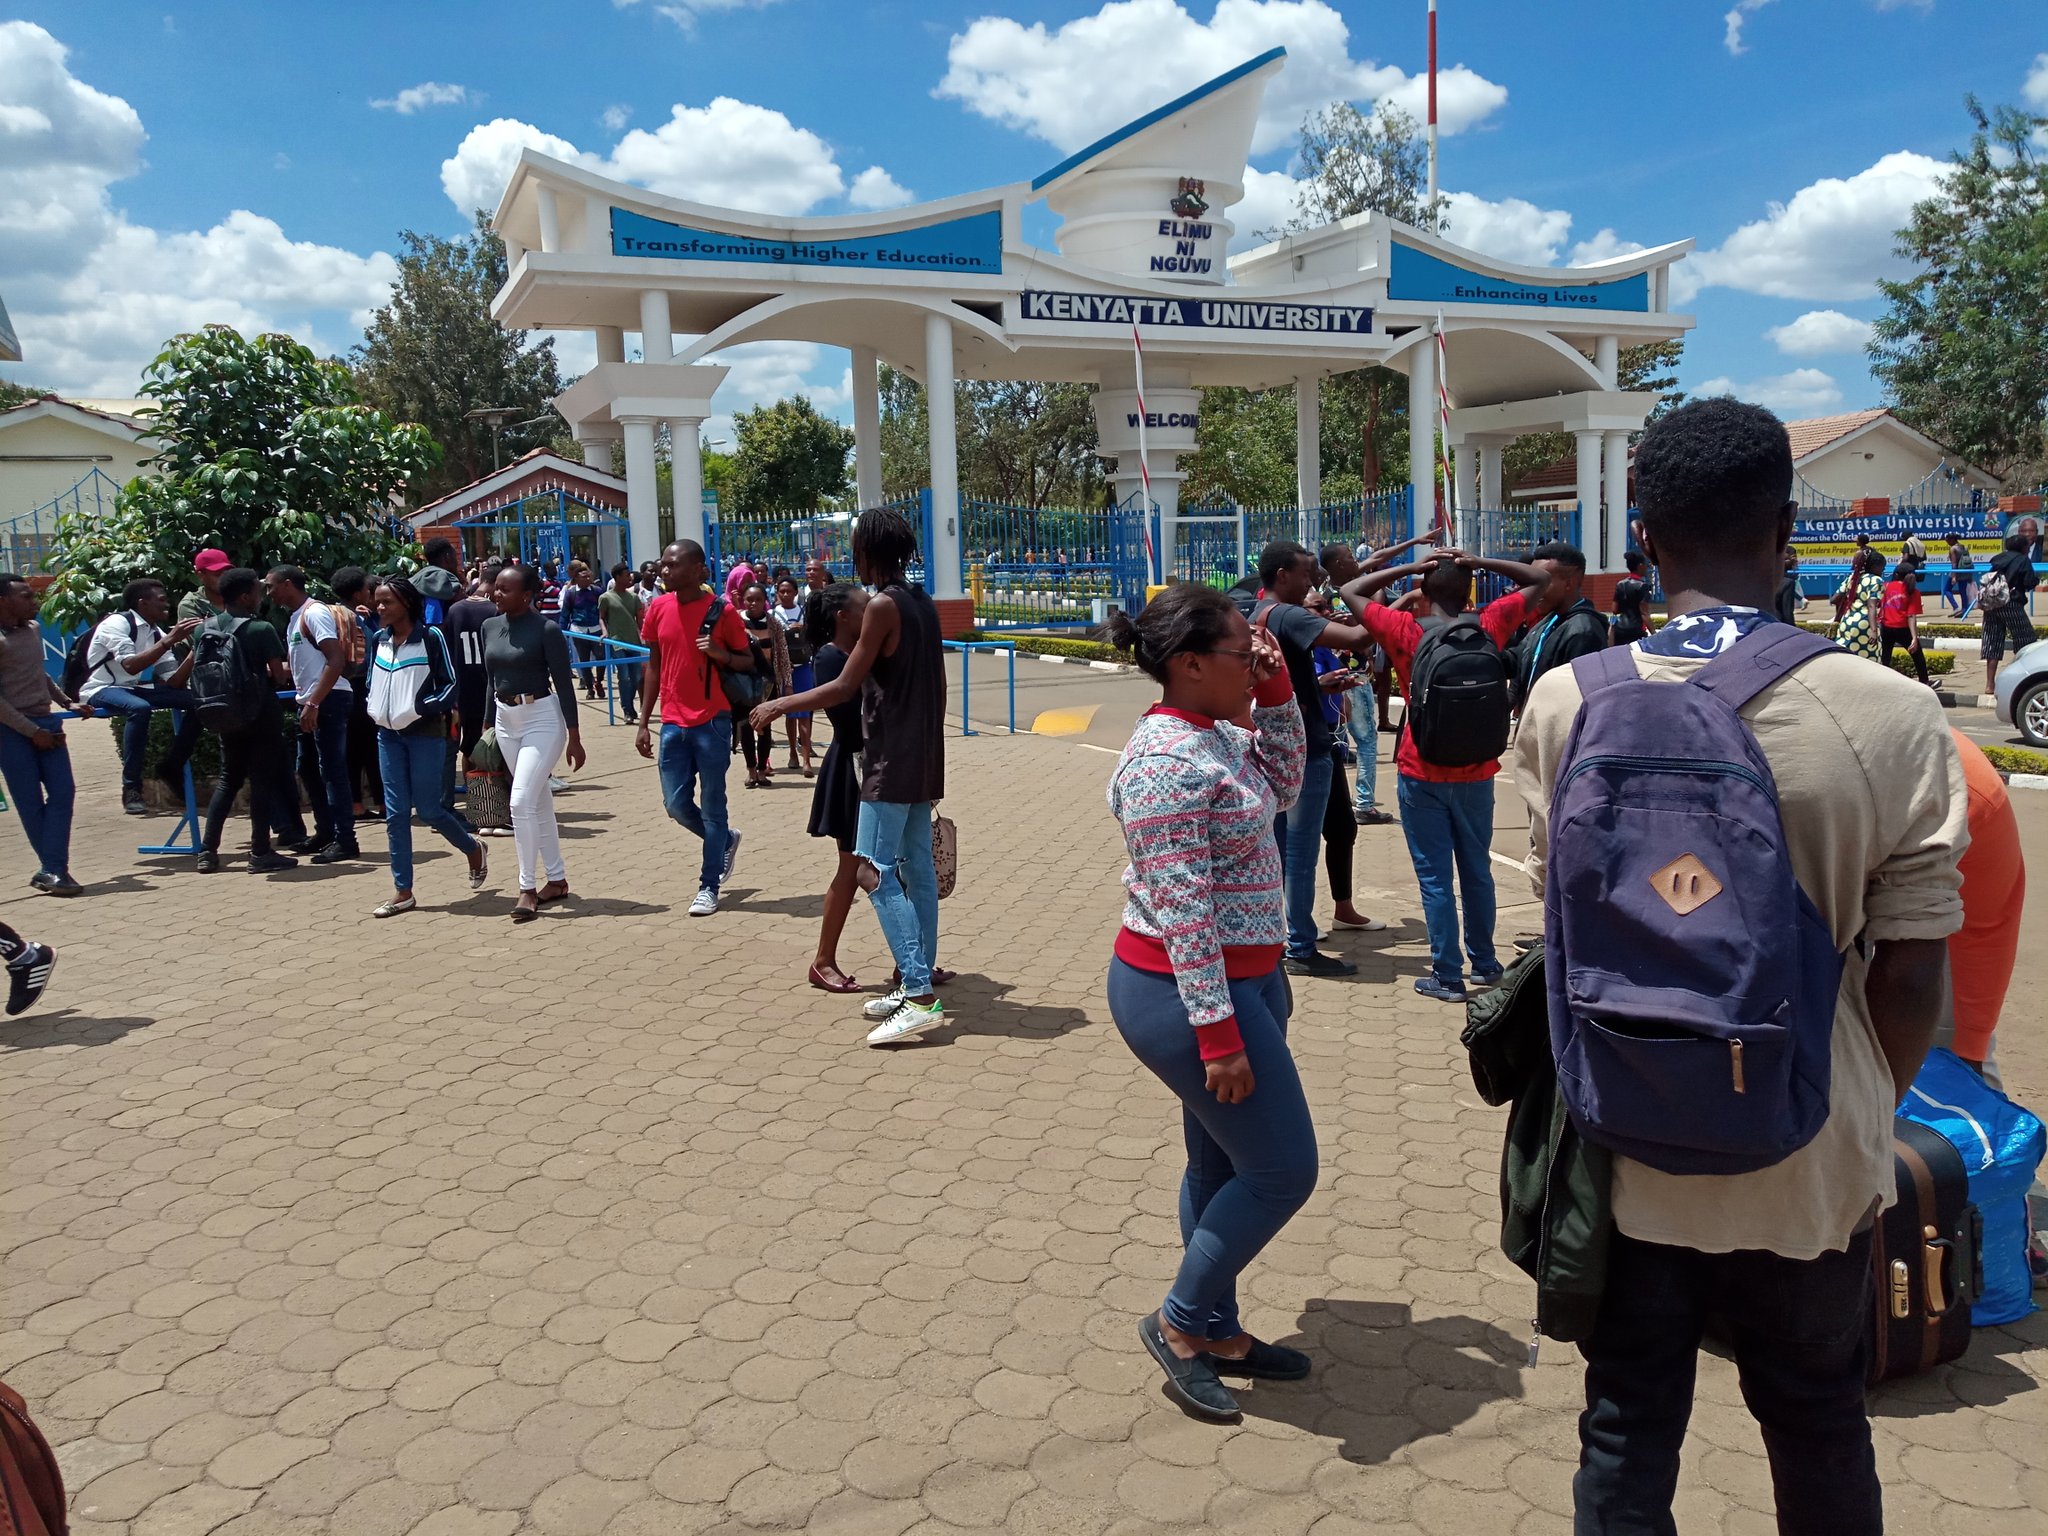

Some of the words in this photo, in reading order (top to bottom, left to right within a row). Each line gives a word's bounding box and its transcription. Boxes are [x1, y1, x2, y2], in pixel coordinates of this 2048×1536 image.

[1158, 219, 1212, 240] ELIMU
[621, 237, 786, 261] Transforming
[791, 245, 869, 263] Higher
[1176, 241, 1195, 256] NI
[1150, 256, 1212, 275] NGUVU
[1554, 290, 1598, 304] Lives
[1029, 292, 1184, 325] KENYATTA
[1201, 302, 1364, 331] UNIVERSITY
[1805, 518, 1880, 533] Kenyatta
[1886, 514, 1974, 531] University
[1965, 530, 2003, 538] 2019/2020
[1805, 546, 1830, 555] Leaders
[1972, 543, 2001, 552] Mentorship
[459, 631, 482, 665] 11
